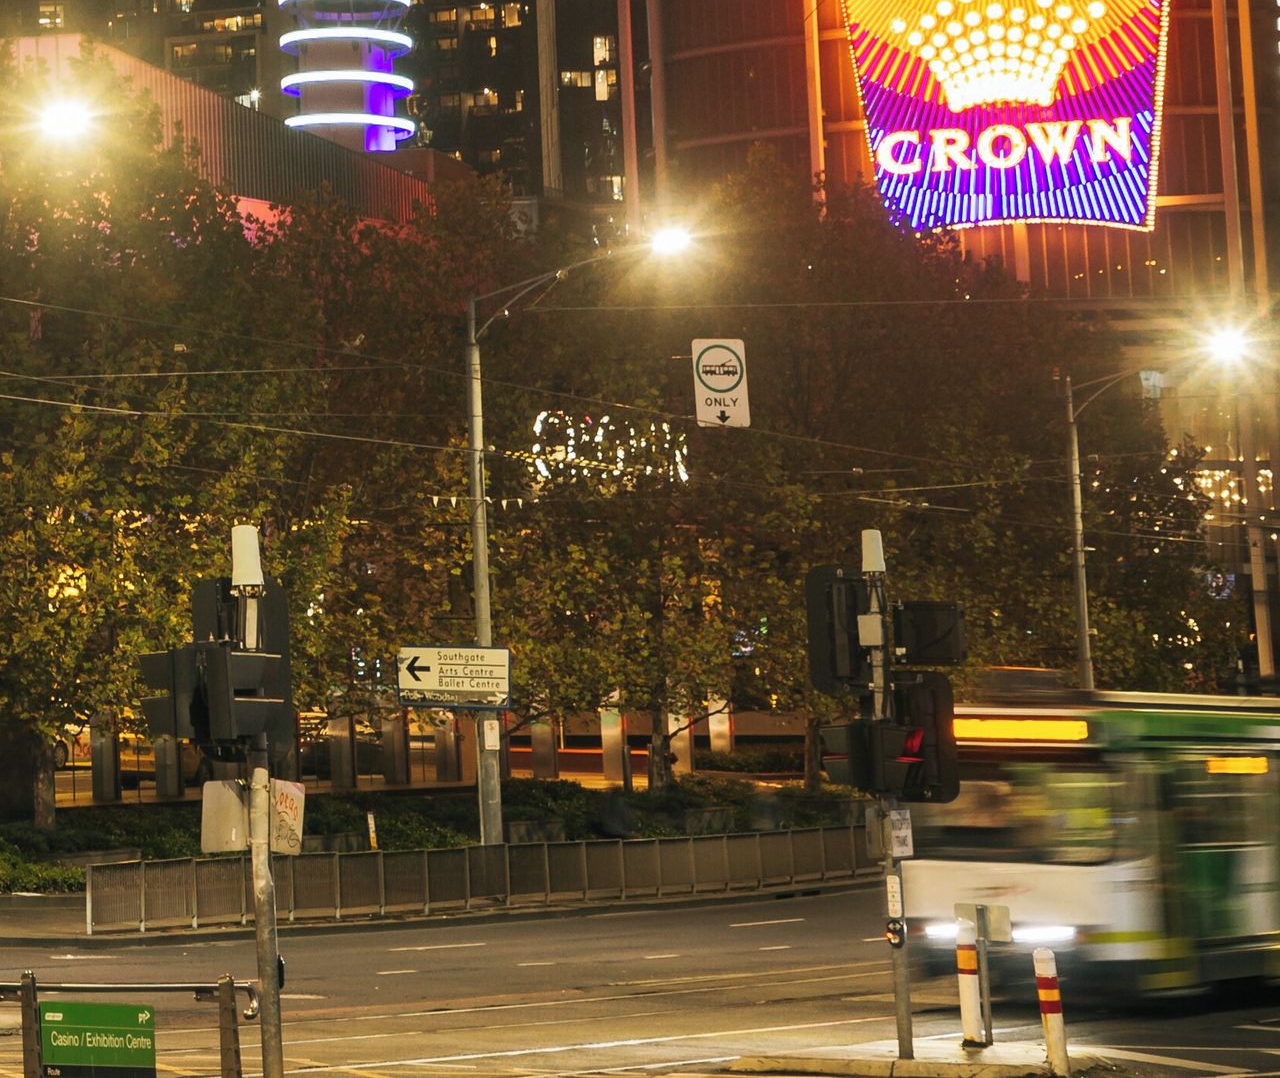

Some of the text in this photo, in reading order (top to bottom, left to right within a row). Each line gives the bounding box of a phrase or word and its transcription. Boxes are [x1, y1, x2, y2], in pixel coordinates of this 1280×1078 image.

[876, 117, 1133, 175] CROWN
[705, 397, 738, 407] ONLY
[437, 651, 485, 663] Southgate
[439, 666, 494, 676] Arts Centre
[438, 677, 500, 689] Ballet Centre
[50, 1030, 80, 1047] Casino
[86, 1032, 125, 1049] Exhibition
[126, 1033, 152, 1049] Centre
[47, 1067, 61, 1076] Route
